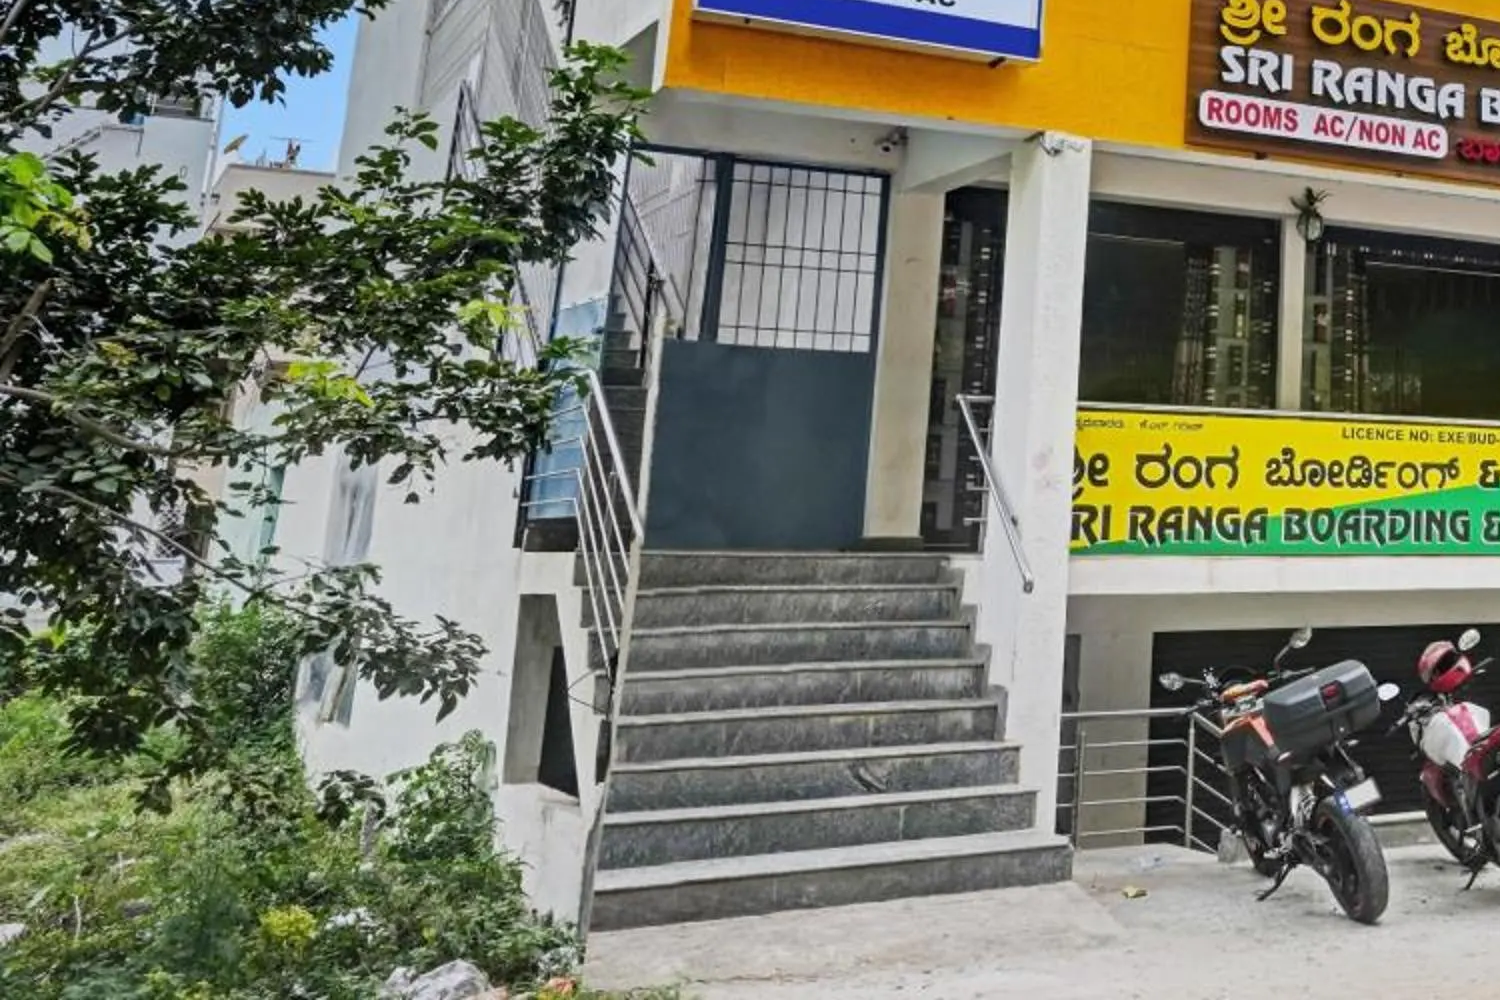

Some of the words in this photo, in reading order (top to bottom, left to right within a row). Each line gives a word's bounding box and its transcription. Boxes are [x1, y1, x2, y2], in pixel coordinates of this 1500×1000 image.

[1220, 45, 1294, 93] SRI
[1311, 58, 1465, 120] RANGA
[1206, 96, 1299, 132] ROOMS
[1313, 114, 1406, 148] AC/NON
[1412, 128, 1442, 152] AC
[1341, 426, 1405, 442] LICENCE
[1135, 442, 1240, 490] ರಂಗ
[1071, 504, 1112, 545] RI
[1128, 504, 1268, 547] RANGA
[1283, 507, 1471, 547] BOARDING
